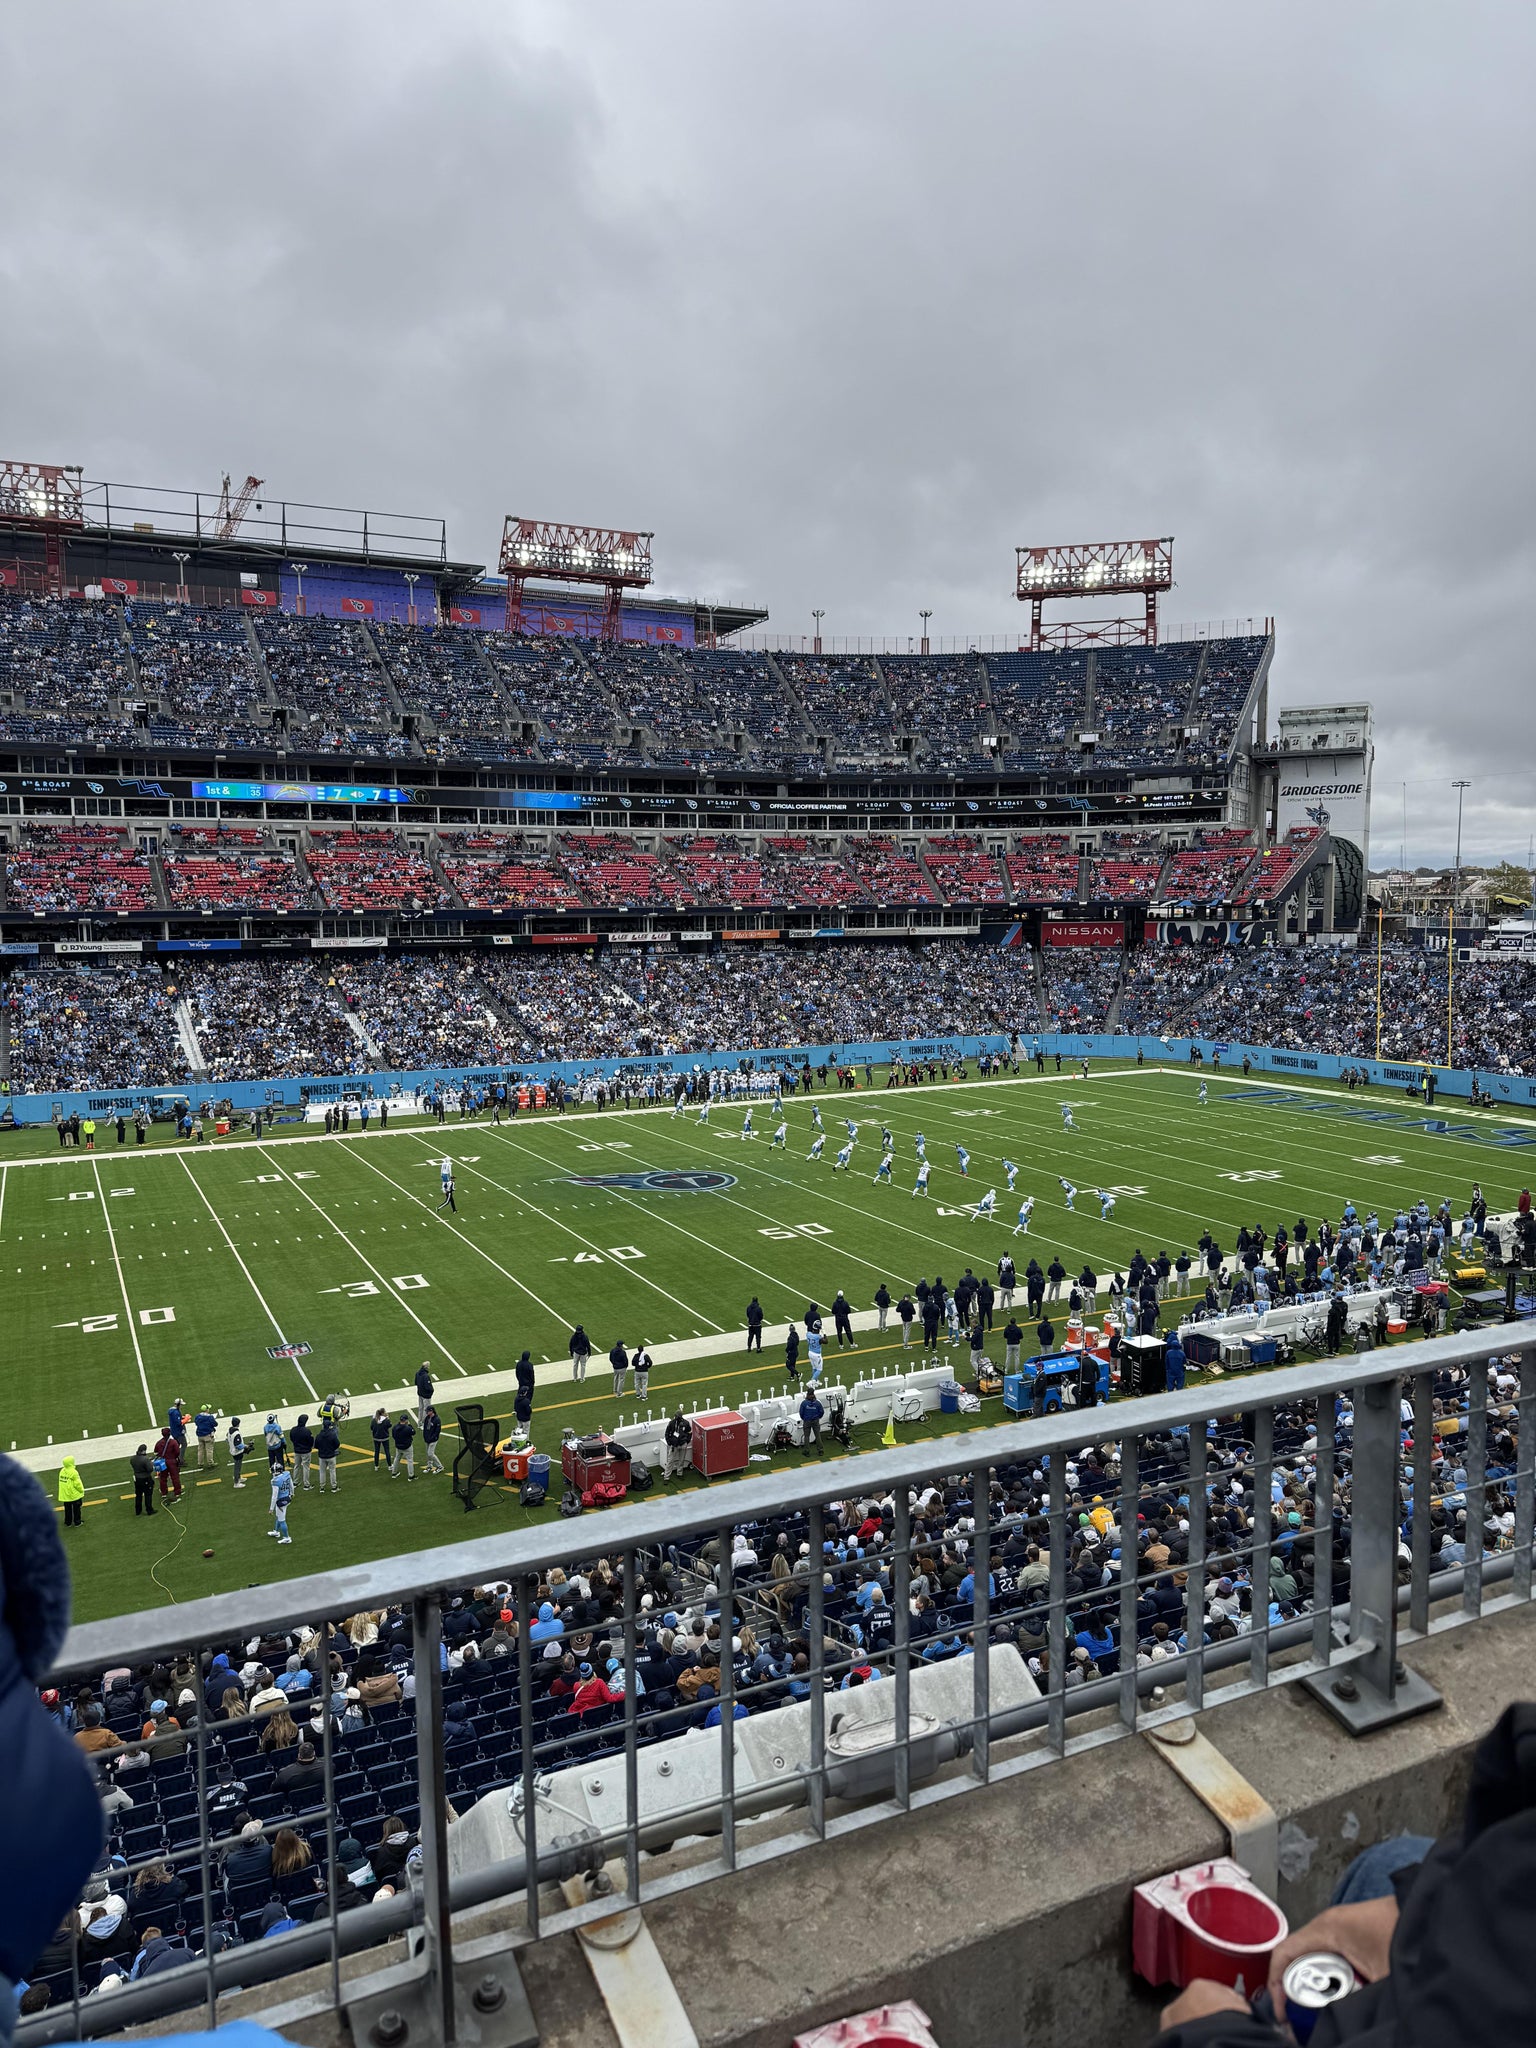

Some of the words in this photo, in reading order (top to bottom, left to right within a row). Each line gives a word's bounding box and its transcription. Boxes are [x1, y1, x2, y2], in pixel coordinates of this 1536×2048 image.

[206, 786, 220, 795] 1st
[222, 786, 230, 795] &
[250, 788, 261, 797] 35
[334, 789, 342, 800] 7
[372, 790, 381, 801] 7
[1280, 784, 1363, 796] BRIDGESTONE
[1052, 926, 1114, 936] NISSAN
[909, 1045, 936, 1055] TENNESSEE
[1271, 1055, 1299, 1068] TENNESSEE
[1300, 1059, 1318, 1070] TOUGH
[1384, 1068, 1416, 1082] TENNESSEE
[576, 1142, 633, 1152] 50
[426, 1156, 481, 1166] 40
[1351, 1155, 1406, 1166] 10
[256, 1171, 321, 1184] 30
[1217, 1170, 1284, 1182] 20
[68, 1187, 136, 1201] 20
[757, 1222, 834, 1240] 50
[572, 1245, 648, 1264] 40
[341, 1273, 431, 1298] 30
[82, 1306, 176, 1333] 20
[507, 1459, 519, 1473] G
[999, 1578, 1014, 1592] 22
[392, 1662, 409, 1671] SPEARS
